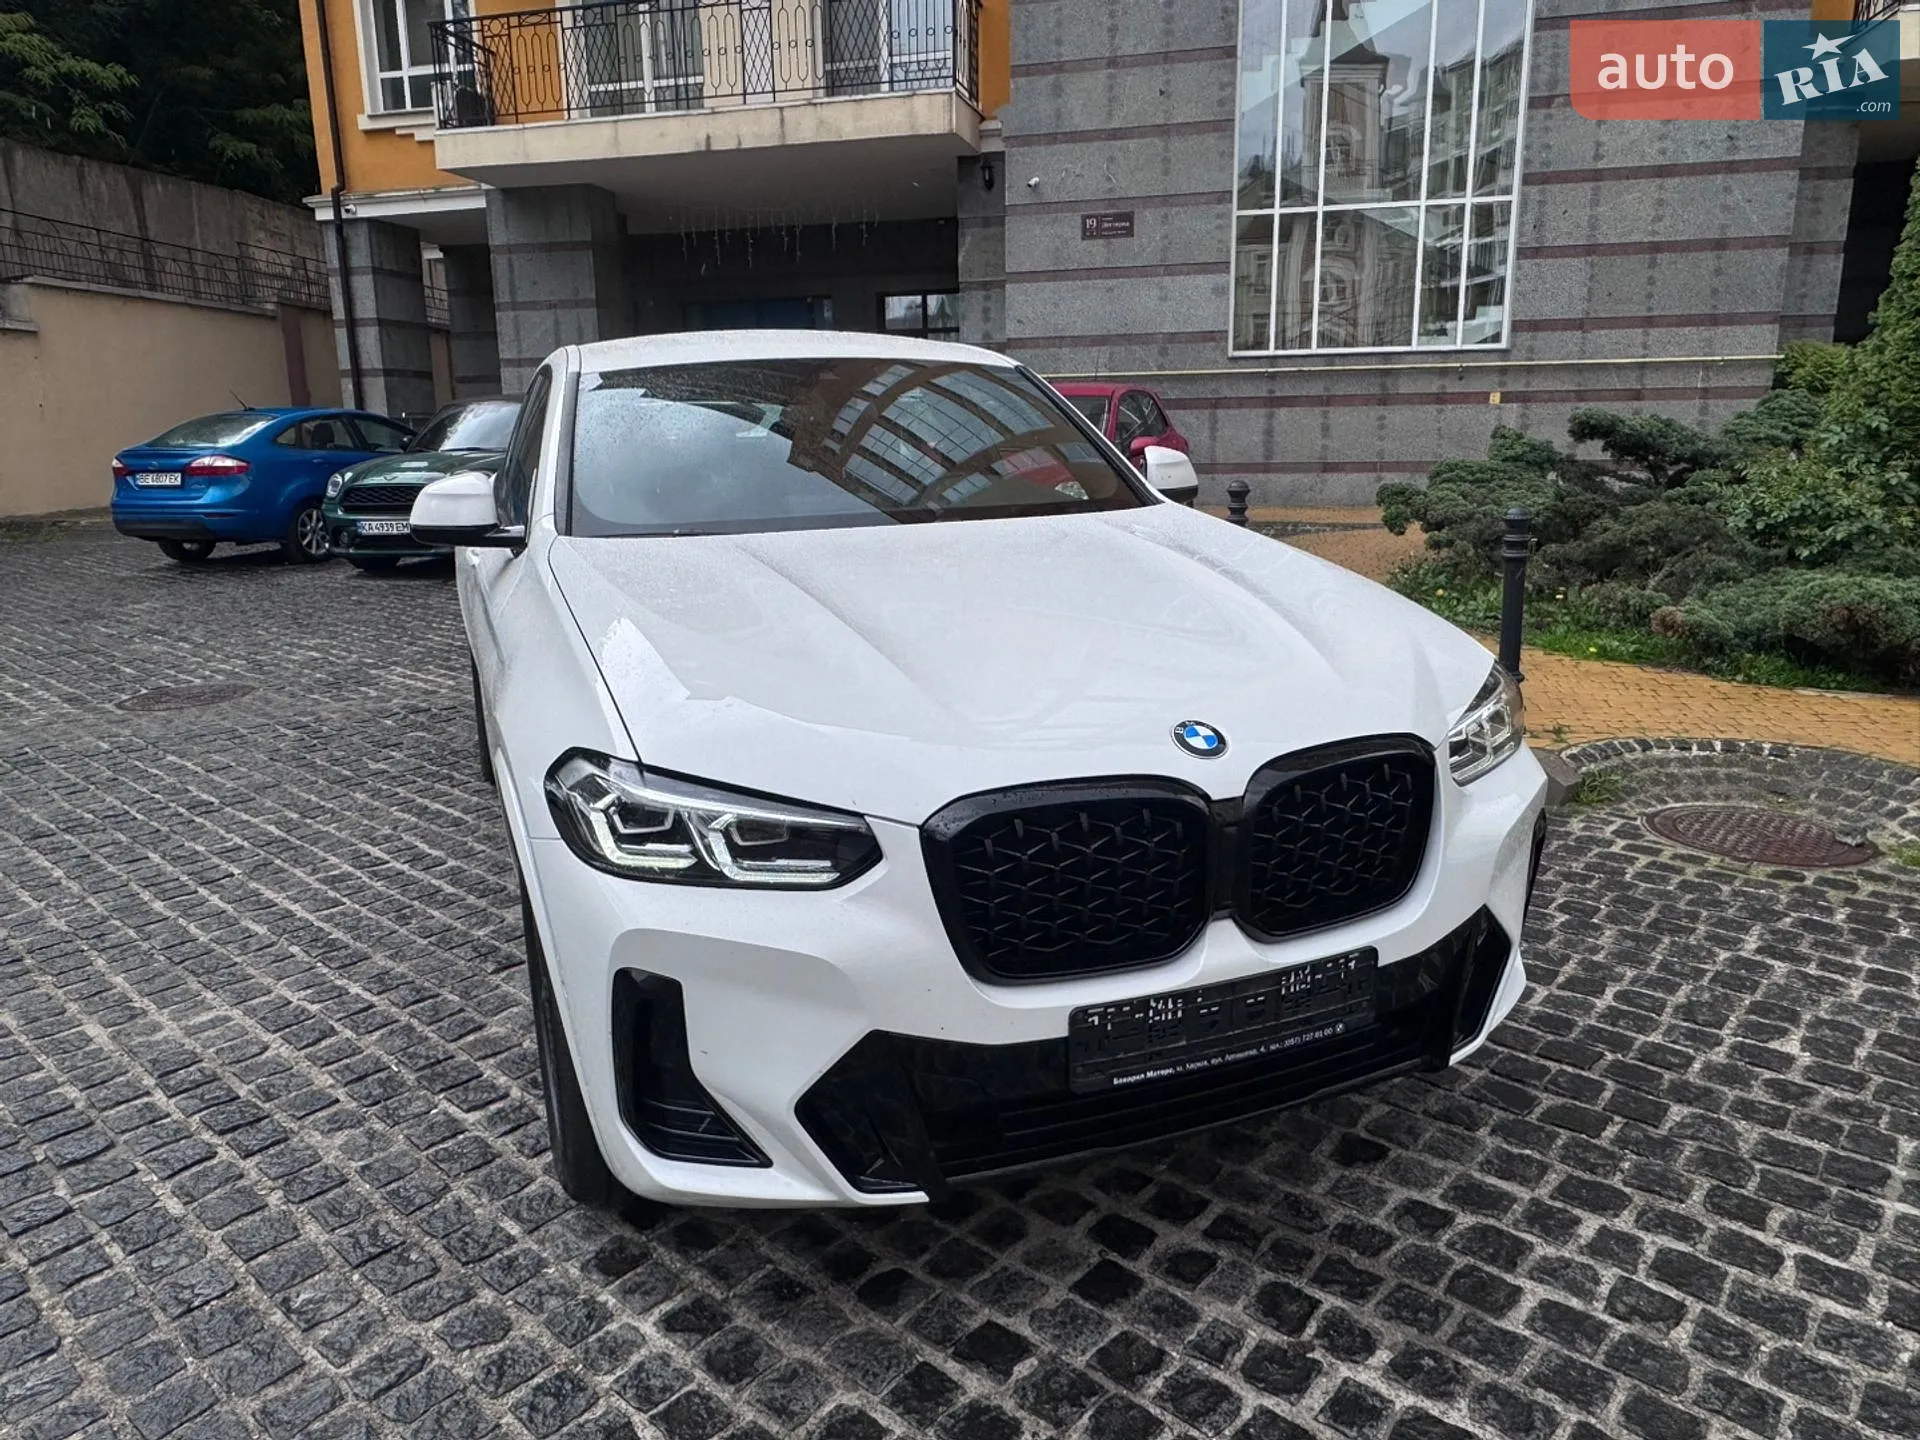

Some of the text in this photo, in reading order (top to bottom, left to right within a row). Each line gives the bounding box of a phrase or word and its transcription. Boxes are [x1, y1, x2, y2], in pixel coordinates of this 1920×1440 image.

[1086, 217, 1096, 229] 19
[362, 522, 374, 532] KA
[375, 522, 394, 532] 4939
